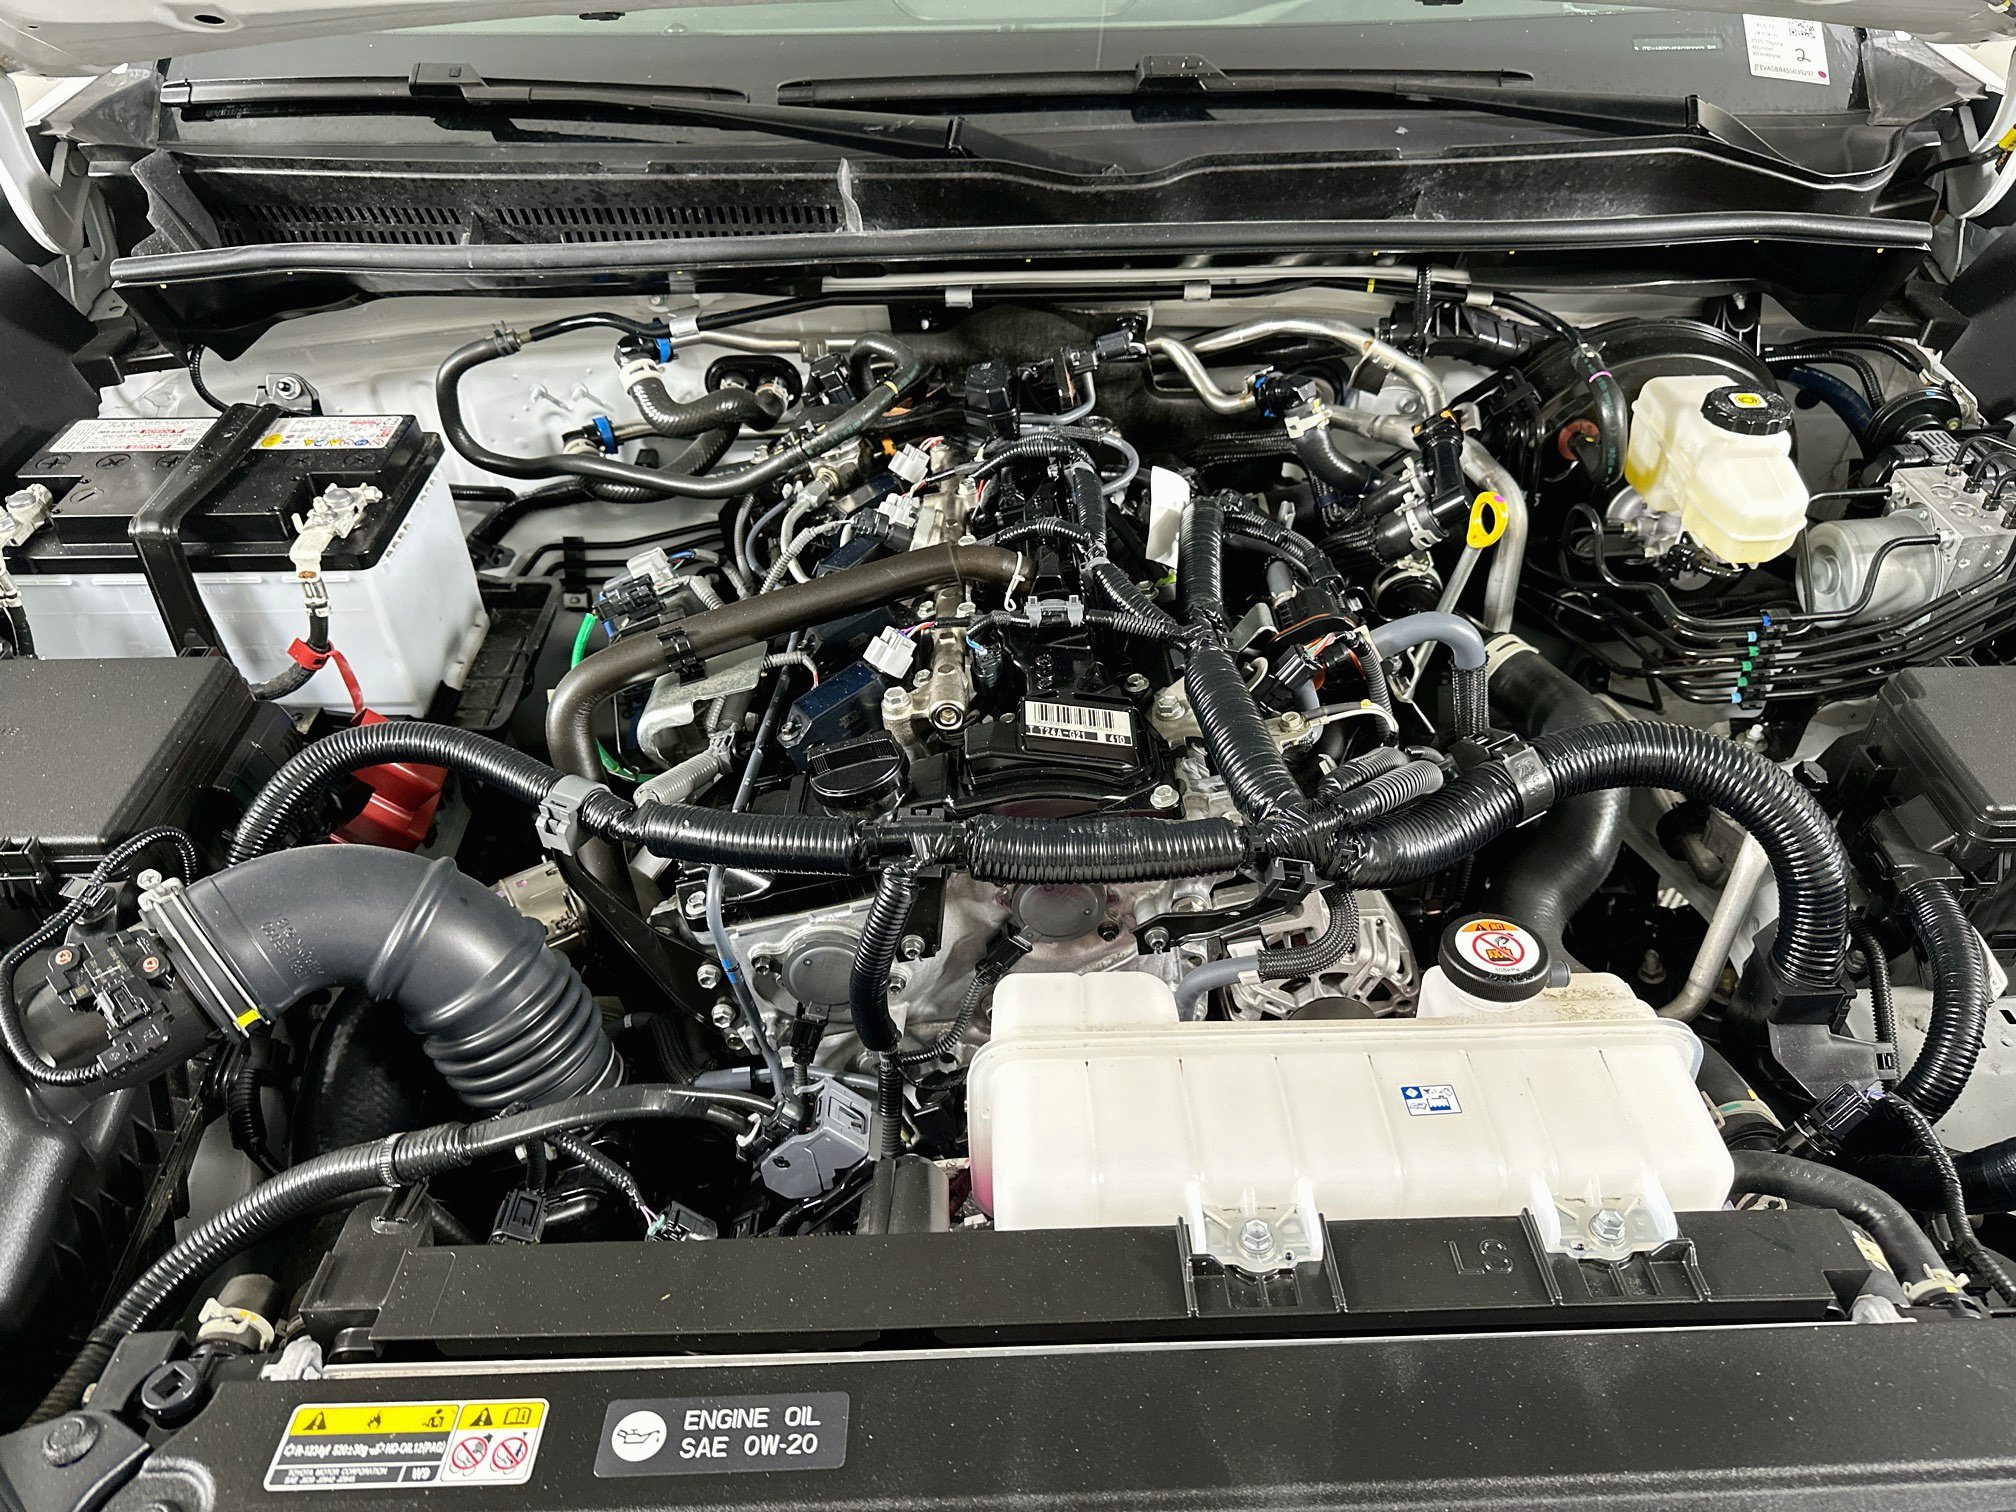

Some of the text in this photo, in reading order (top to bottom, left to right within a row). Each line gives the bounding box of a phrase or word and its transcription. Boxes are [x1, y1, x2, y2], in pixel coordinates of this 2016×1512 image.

[1795, 48, 1812, 62] 2
[1109, 734, 1126, 744] 410
[1448, 1239, 1514, 1275] LS
[683, 1405, 821, 1431] ENGINE OIL
[679, 1433, 818, 1459] SAE 0W-20
